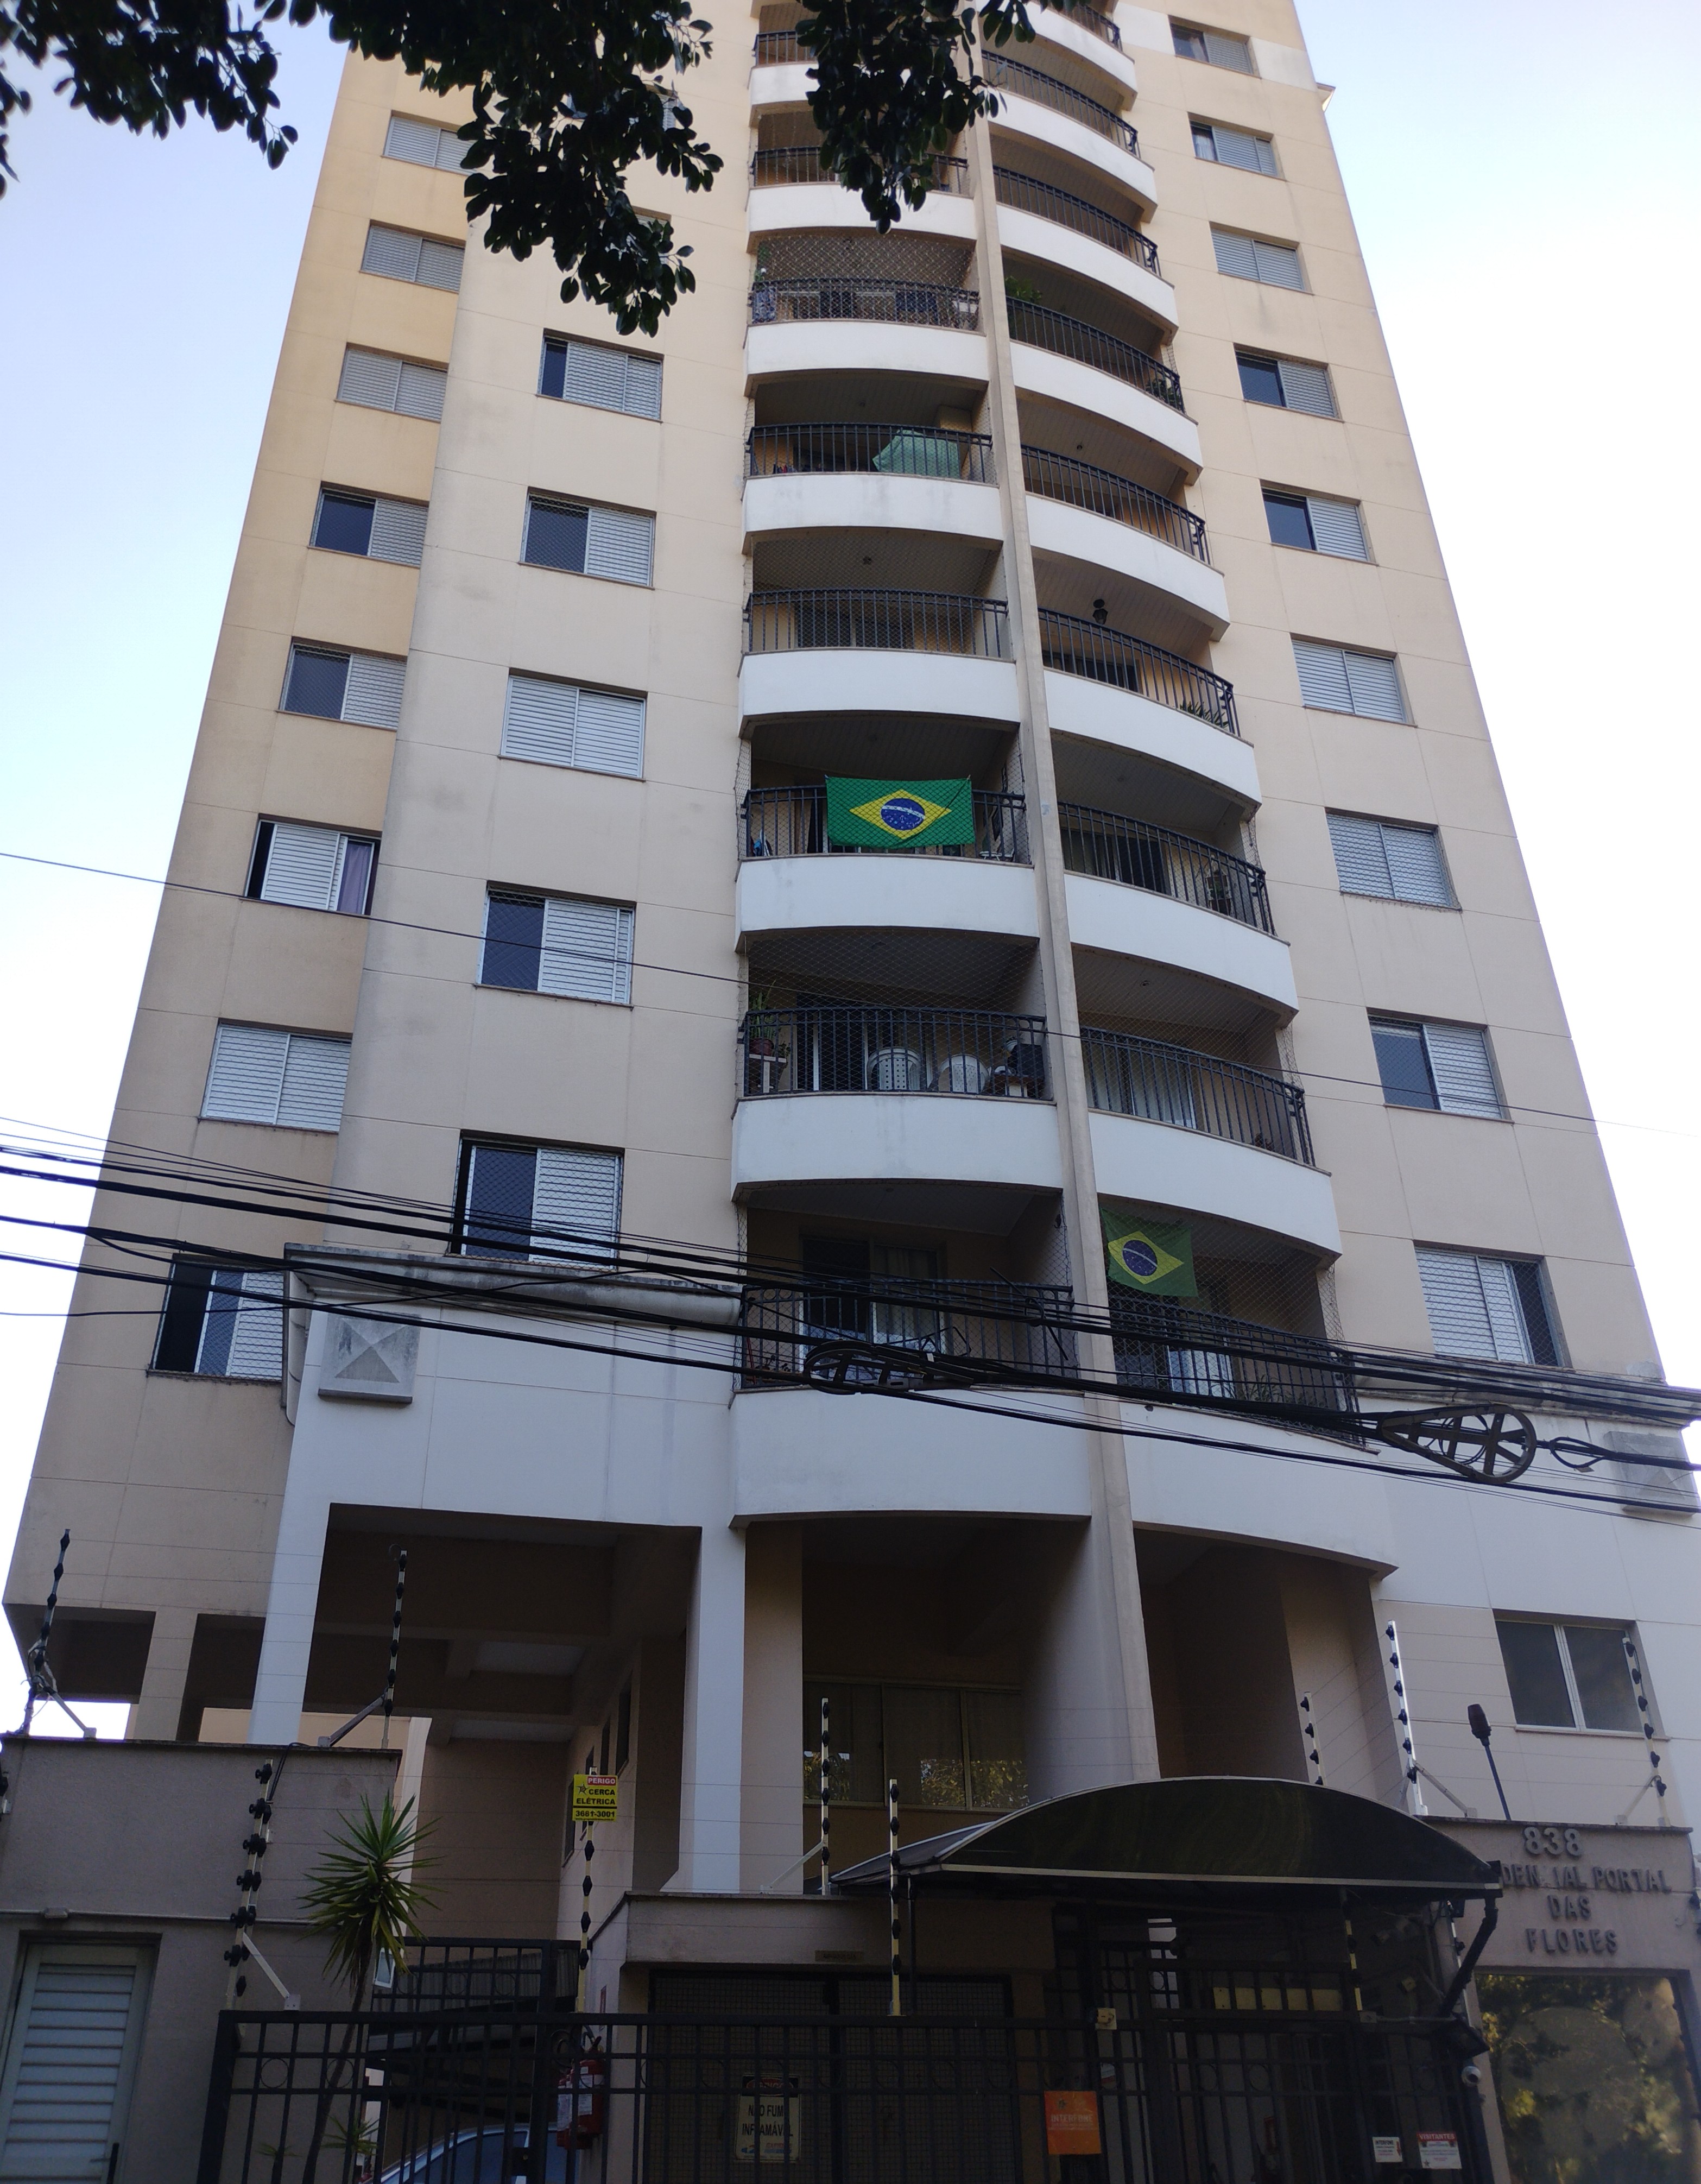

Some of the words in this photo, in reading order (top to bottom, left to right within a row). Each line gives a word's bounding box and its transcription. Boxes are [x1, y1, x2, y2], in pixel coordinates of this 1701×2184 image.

[576, 1797, 616, 1805] ELÉTRICA
[1523, 1827, 1585, 1857] 838
[1593, 1866, 1672, 1893] PORTAL
[1547, 1895, 1592, 1920] DAS
[1525, 1928, 1618, 1954] FLORES
[748, 2104, 764, 2117] NO
[767, 2105, 785, 2117] FUM
[742, 2121, 794, 2137] INFAMÁVL
